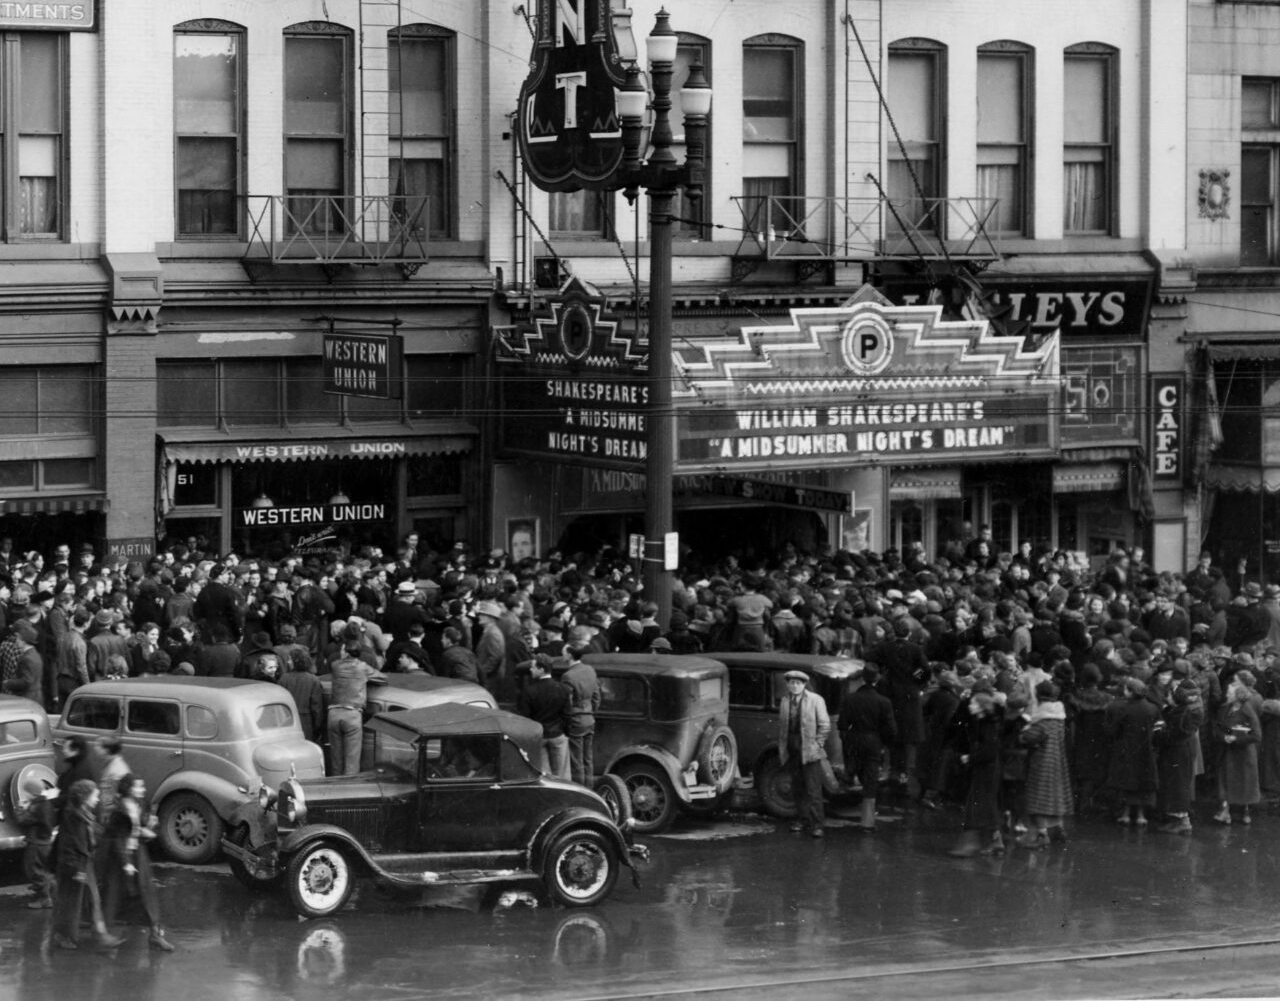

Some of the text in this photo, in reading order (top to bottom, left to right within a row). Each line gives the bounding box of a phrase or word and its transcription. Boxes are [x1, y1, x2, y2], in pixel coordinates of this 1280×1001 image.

[324, 340, 386, 365] WESTERN
[861, 334, 878, 359] P
[334, 366, 377, 391] UNION
[547, 380, 649, 404] SHAKESPEARE'S
[580, 411, 645, 432] MIDSUMME
[735, 401, 985, 430] WILLIAM SHAKESPEARE'S
[236, 442, 406, 458] WESTERN UNION
[548, 432, 599, 453] NIGHT'S
[738, 433, 849, 458] MIDSUMMER
[856, 429, 934, 452] NIGHT'S
[178, 474, 194, 485] 51
[243, 504, 385, 525] WESTERN UNION
[111, 543, 151, 556] MARTIN
